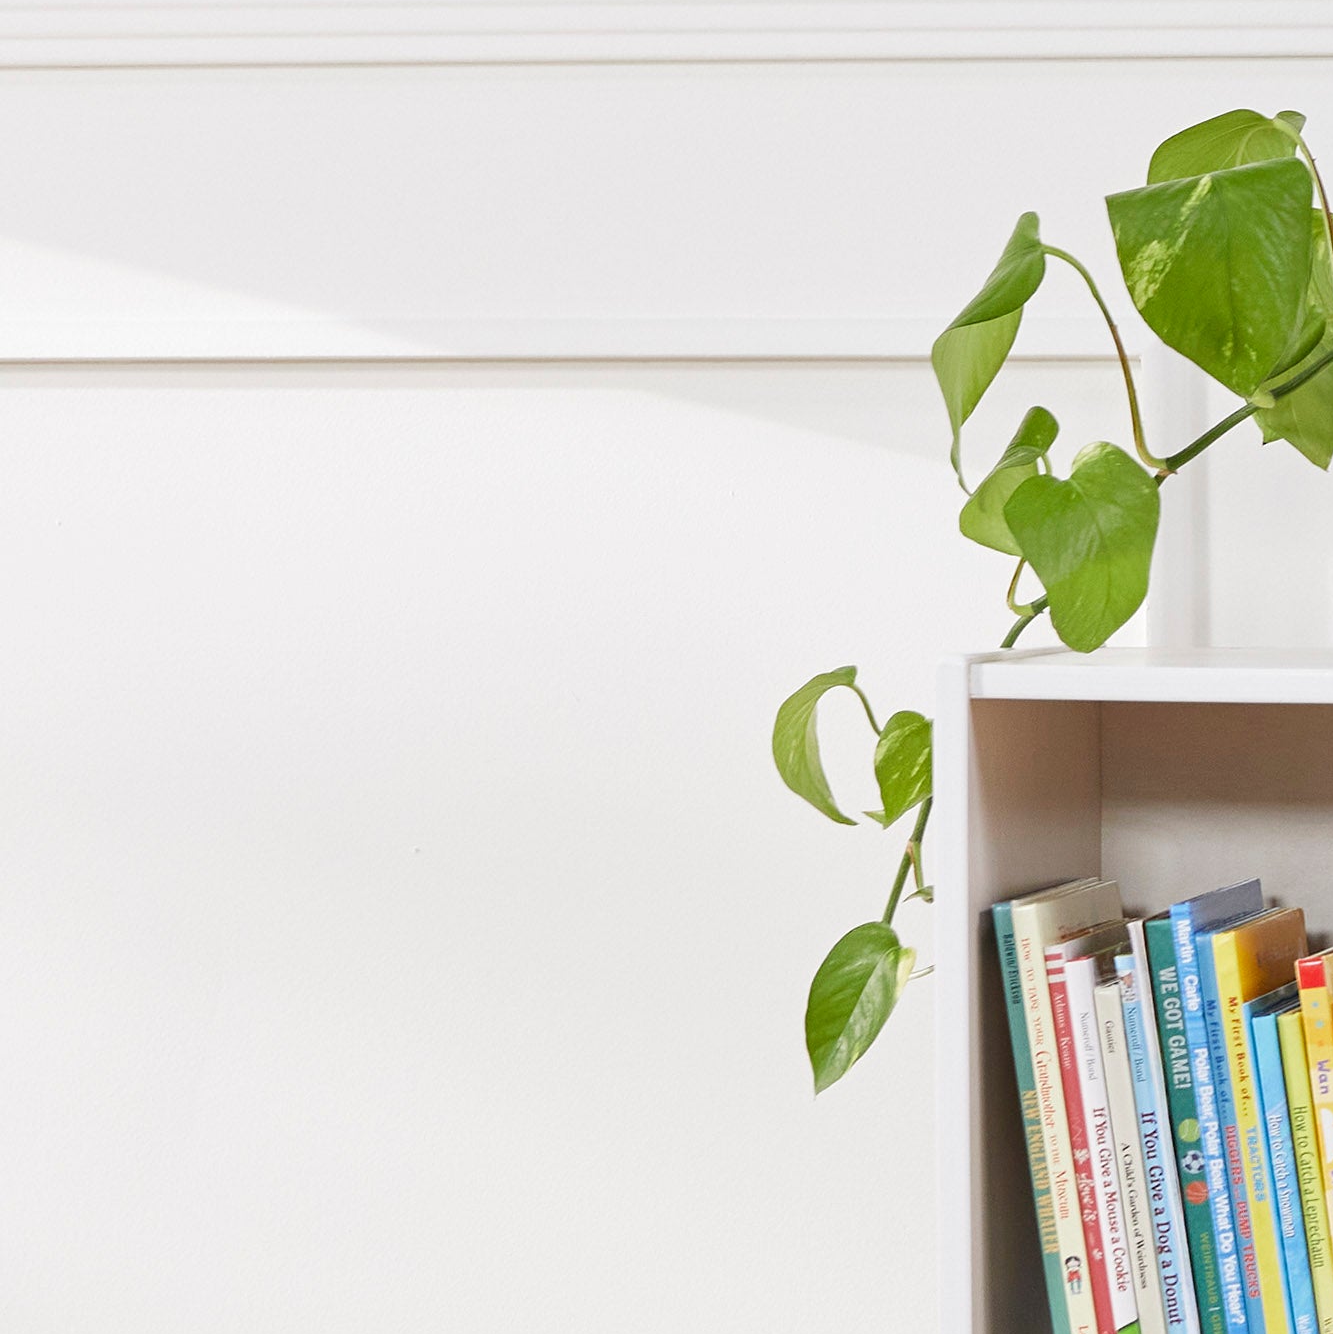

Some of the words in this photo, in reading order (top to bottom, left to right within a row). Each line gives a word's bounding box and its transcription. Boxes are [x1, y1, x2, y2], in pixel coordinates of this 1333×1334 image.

[1176, 919, 1195, 964] Martin
[1158, 966, 1178, 994] WE
[1183, 974, 1199, 1012] Carle
[1163, 997, 1183, 1030] GOT
[1228, 996, 1238, 1014] My
[1127, 1006, 1142, 1051] Numeroff
[1135, 1058, 1146, 1083] Bond
[1232, 1018, 1242, 1048] First
[1086, 1059, 1098, 1081] Bond
[1168, 1035, 1192, 1090] GAME!
[1194, 1047, 1211, 1082] Polar
[1236, 1053, 1249, 1083] Book
[1316, 1059, 1331, 1095] Wan
[1023, 1090, 1040, 1120] NEW
[1093, 1107, 1105, 1118] If
[1141, 1112, 1154, 1124] If
[1199, 1085, 1217, 1122] Bear,
[1293, 1106, 1308, 1133] How
[1095, 1121, 1109, 1145] You
[1204, 1121, 1220, 1156] Polar
[1267, 1114, 1282, 1139] How
[1297, 1136, 1308, 1148] to
[1028, 1125, 1050, 1189] ENGLAND
[1143, 1128, 1159, 1160] You
[1225, 1125, 1243, 1185] DIGGERS
[1272, 1140, 1282, 1151] to
[1100, 1148, 1113, 1178] Give
[1246, 1126, 1266, 1202] TRACTORS
[1273, 1152, 1289, 1181] Catch
[1299, 1151, 1317, 1186] Catch
[1104, 1181, 1112, 1189] a
[1148, 1166, 1164, 1201] Give
[1304, 1187, 1312, 1196] a
[1038, 1195, 1060, 1254] WHALER
[1105, 1191, 1120, 1234] Mouse
[1154, 1208, 1165, 1217] a
[1214, 1194, 1233, 1231] What
[1236, 1202, 1252, 1239] DUMP
[1280, 1188, 1295, 1238] Snowman
[1111, 1237, 1120, 1246] a
[1156, 1221, 1172, 1254] Dog
[1219, 1234, 1235, 1254] Do
[1304, 1196, 1325, 1269] Leprechaun
[1112, 1249, 1127, 1292] Cookie
[1161, 1260, 1172, 1269] a
[1200, 1231, 1218, 1305] WEINTRAUB
[1223, 1255, 1239, 1282] You
[1242, 1244, 1260, 1299] TRUCKS
[1163, 1273, 1182, 1325] Donut
[1225, 1283, 1245, 1325] Hear?
